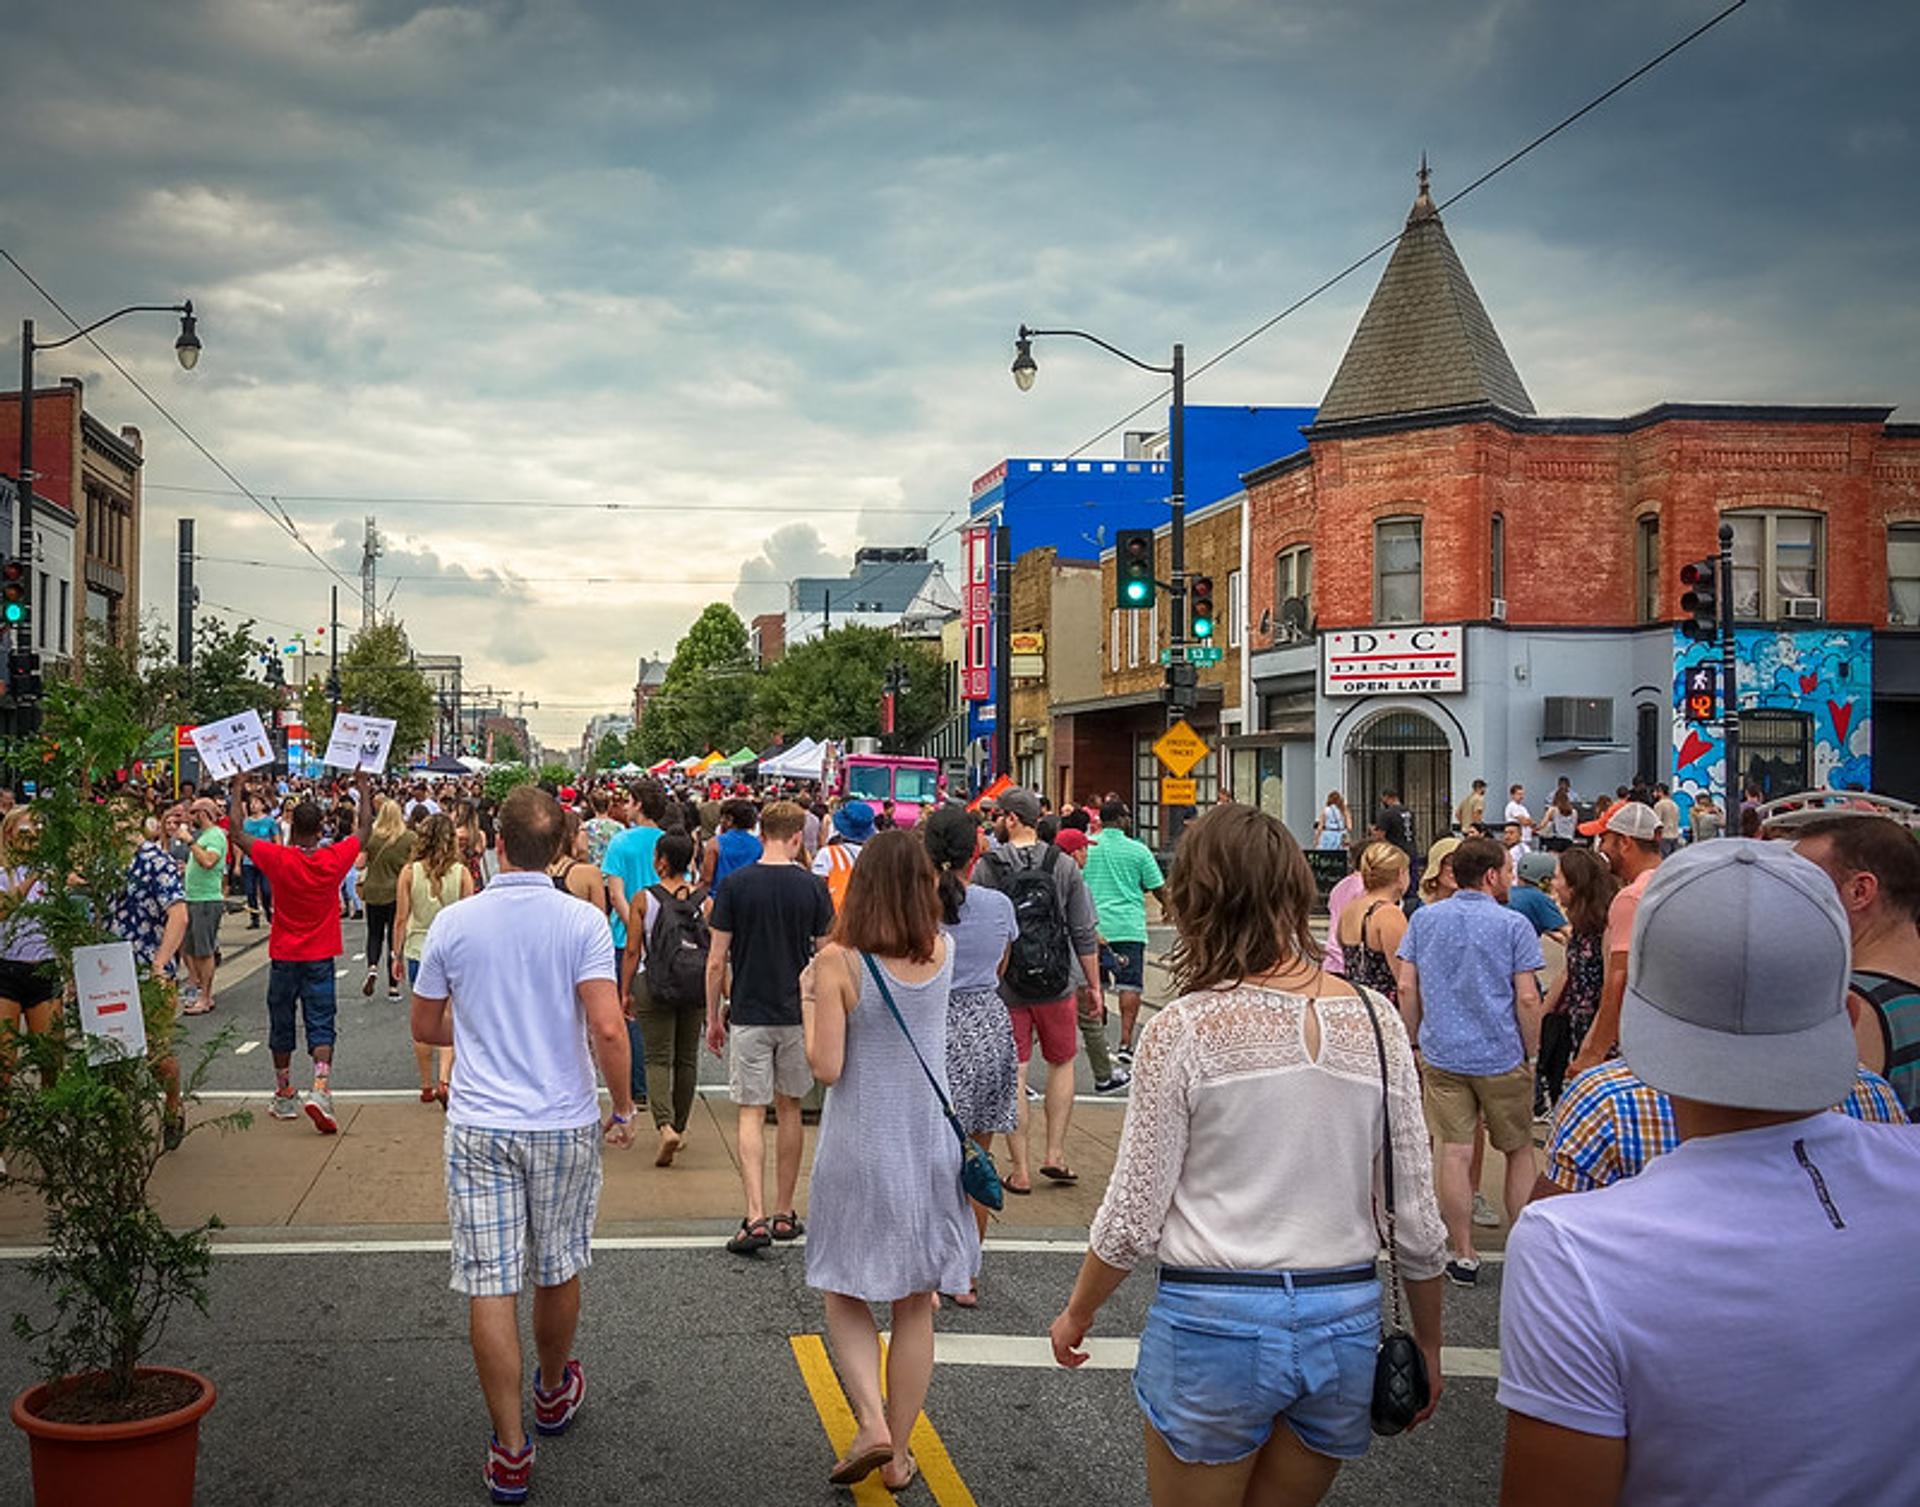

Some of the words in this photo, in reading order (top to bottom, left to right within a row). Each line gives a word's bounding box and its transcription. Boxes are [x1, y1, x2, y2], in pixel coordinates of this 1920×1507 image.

[1352, 634, 1378, 654] D
[1411, 631, 1436, 651] C
[1334, 660, 1451, 673] DINER
[1343, 681, 1389, 692] OPEN
[1397, 680, 1441, 691] LATE
[1692, 695, 1710, 718] 42
